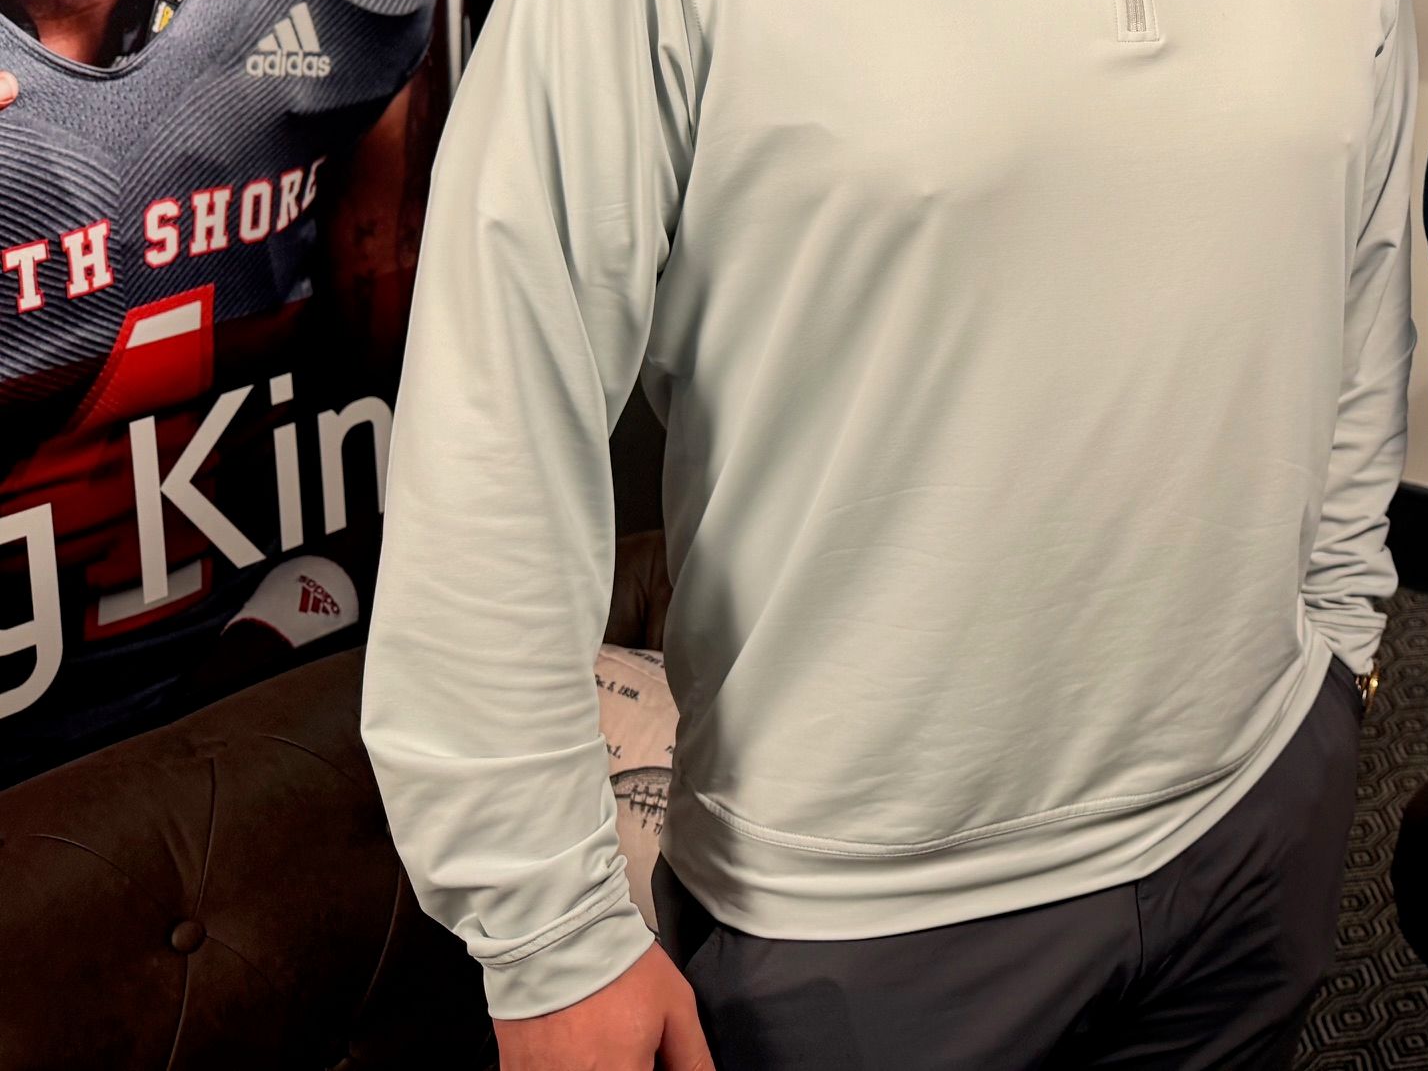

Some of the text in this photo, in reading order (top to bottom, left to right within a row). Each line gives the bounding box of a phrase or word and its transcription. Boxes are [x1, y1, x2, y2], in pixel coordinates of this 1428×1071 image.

[246, 48, 332, 78] adidas
[2, 217, 115, 315] TH
[129, 372, 394, 605] Kin
